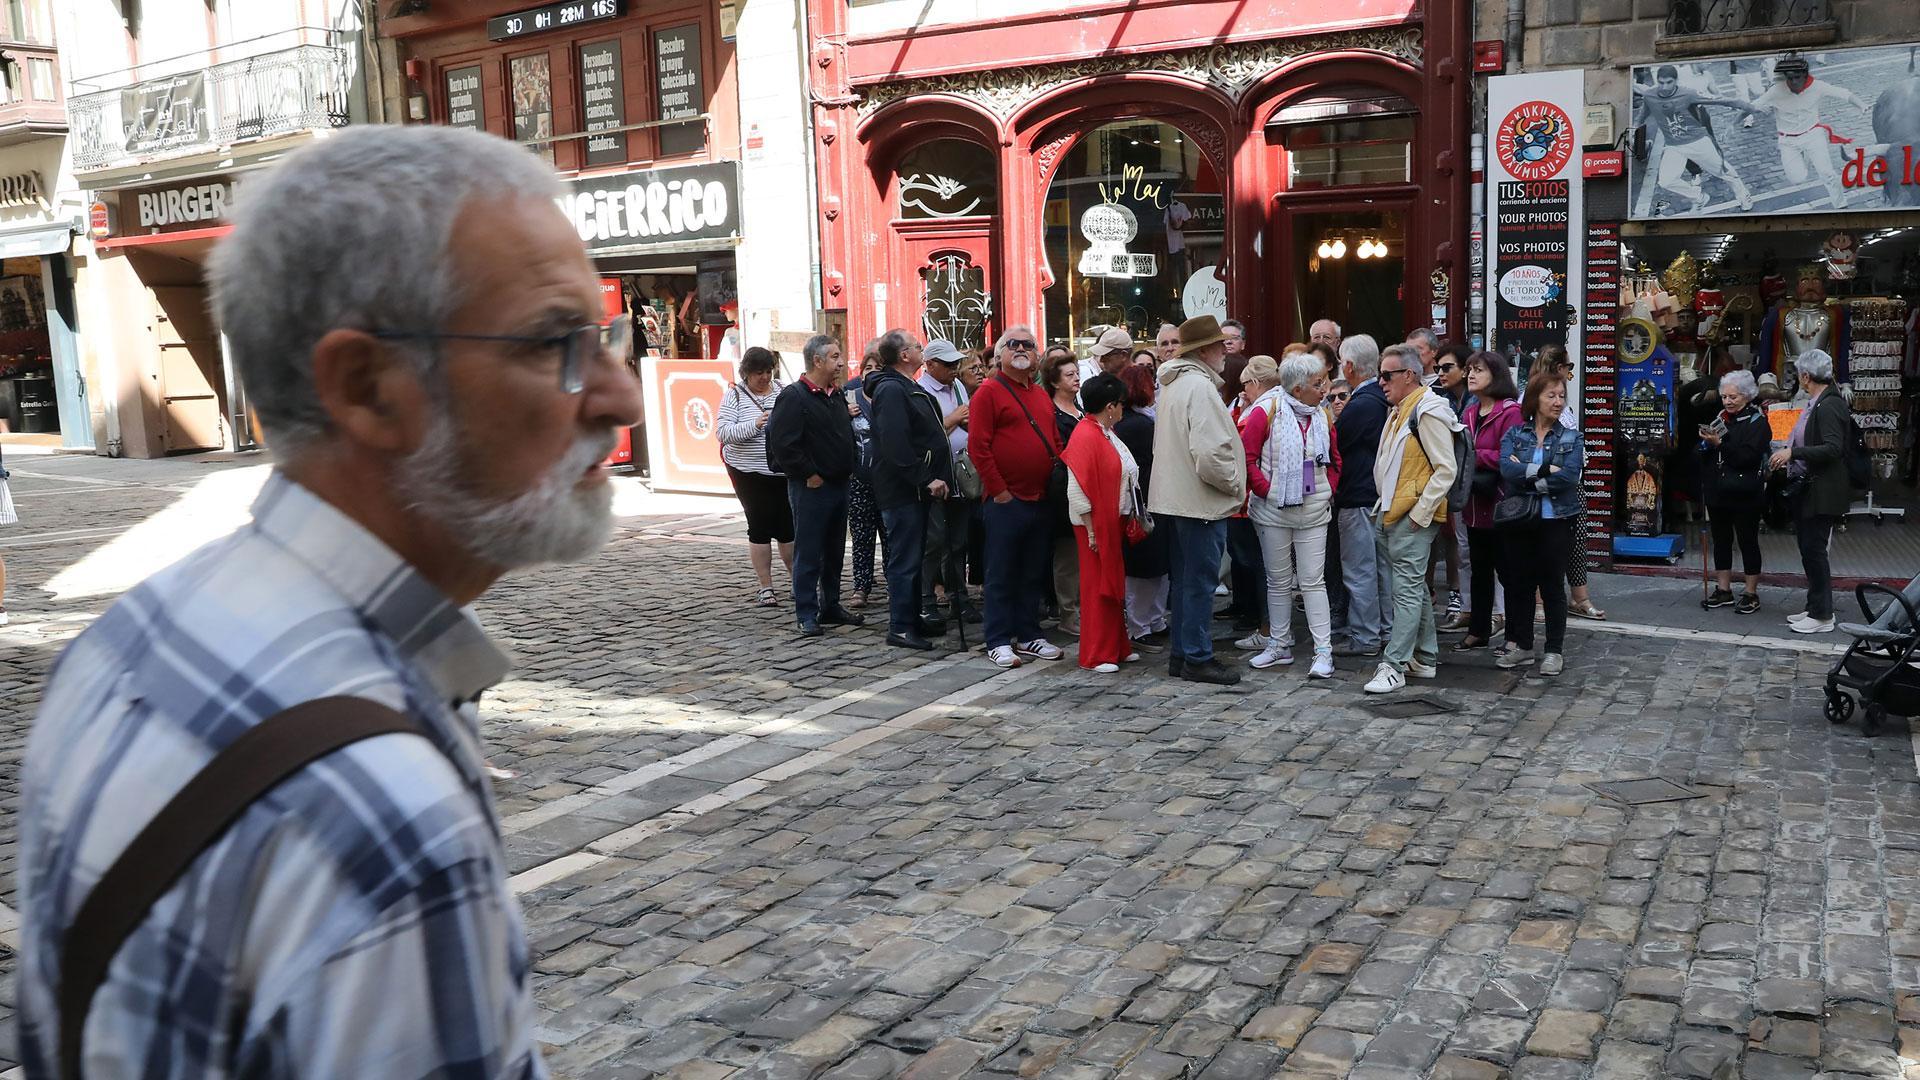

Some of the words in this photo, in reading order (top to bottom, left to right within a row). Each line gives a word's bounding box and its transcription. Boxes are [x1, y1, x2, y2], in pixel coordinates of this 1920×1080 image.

[506, 18, 523, 34] 3D
[535, 11, 551, 28] 0H
[560, 4, 584, 24] 28M
[591, 0, 615, 17] 16S
[659, 36, 685, 55] Descubre
[583, 49, 613, 69] Personaliza
[659, 56, 666, 72] la
[666, 56, 683, 74] mayor
[584, 69, 597, 85] todo
[597, 68, 608, 86] tipo
[608, 66, 615, 82] de
[687, 69, 696, 86] de
[450, 90, 473, 108] corriendo
[585, 85, 613, 106] productos:
[662, 89, 689, 107] souvenirs
[451, 109, 457, 124] el
[457, 108, 476, 123] encierro
[586, 103, 615, 119] camisetas,
[1593, 157, 1620, 167] prodein
[1841, 147, 1889, 188] de
[138, 183, 227, 227] BURGER
[1500, 197, 1530, 206] corriendo
[1540, 197, 1567, 205] encierro
[1499, 213, 1526, 223] YOUR
[1528, 211, 1567, 222] PHOTOS
[1499, 243, 1521, 253] VOS
[1523, 241, 1565, 253] PHOTOS
[1511, 269, 1520, 279] 10
[1521, 268, 1540, 279] AÑOS
[1504, 287, 1516, 295] DE
[1518, 286, 1545, 295] TOROS
[1519, 309, 1544, 318] CALLE
[1503, 320, 1544, 330] ESTAFETA
[1546, 320, 1557, 329] 41
